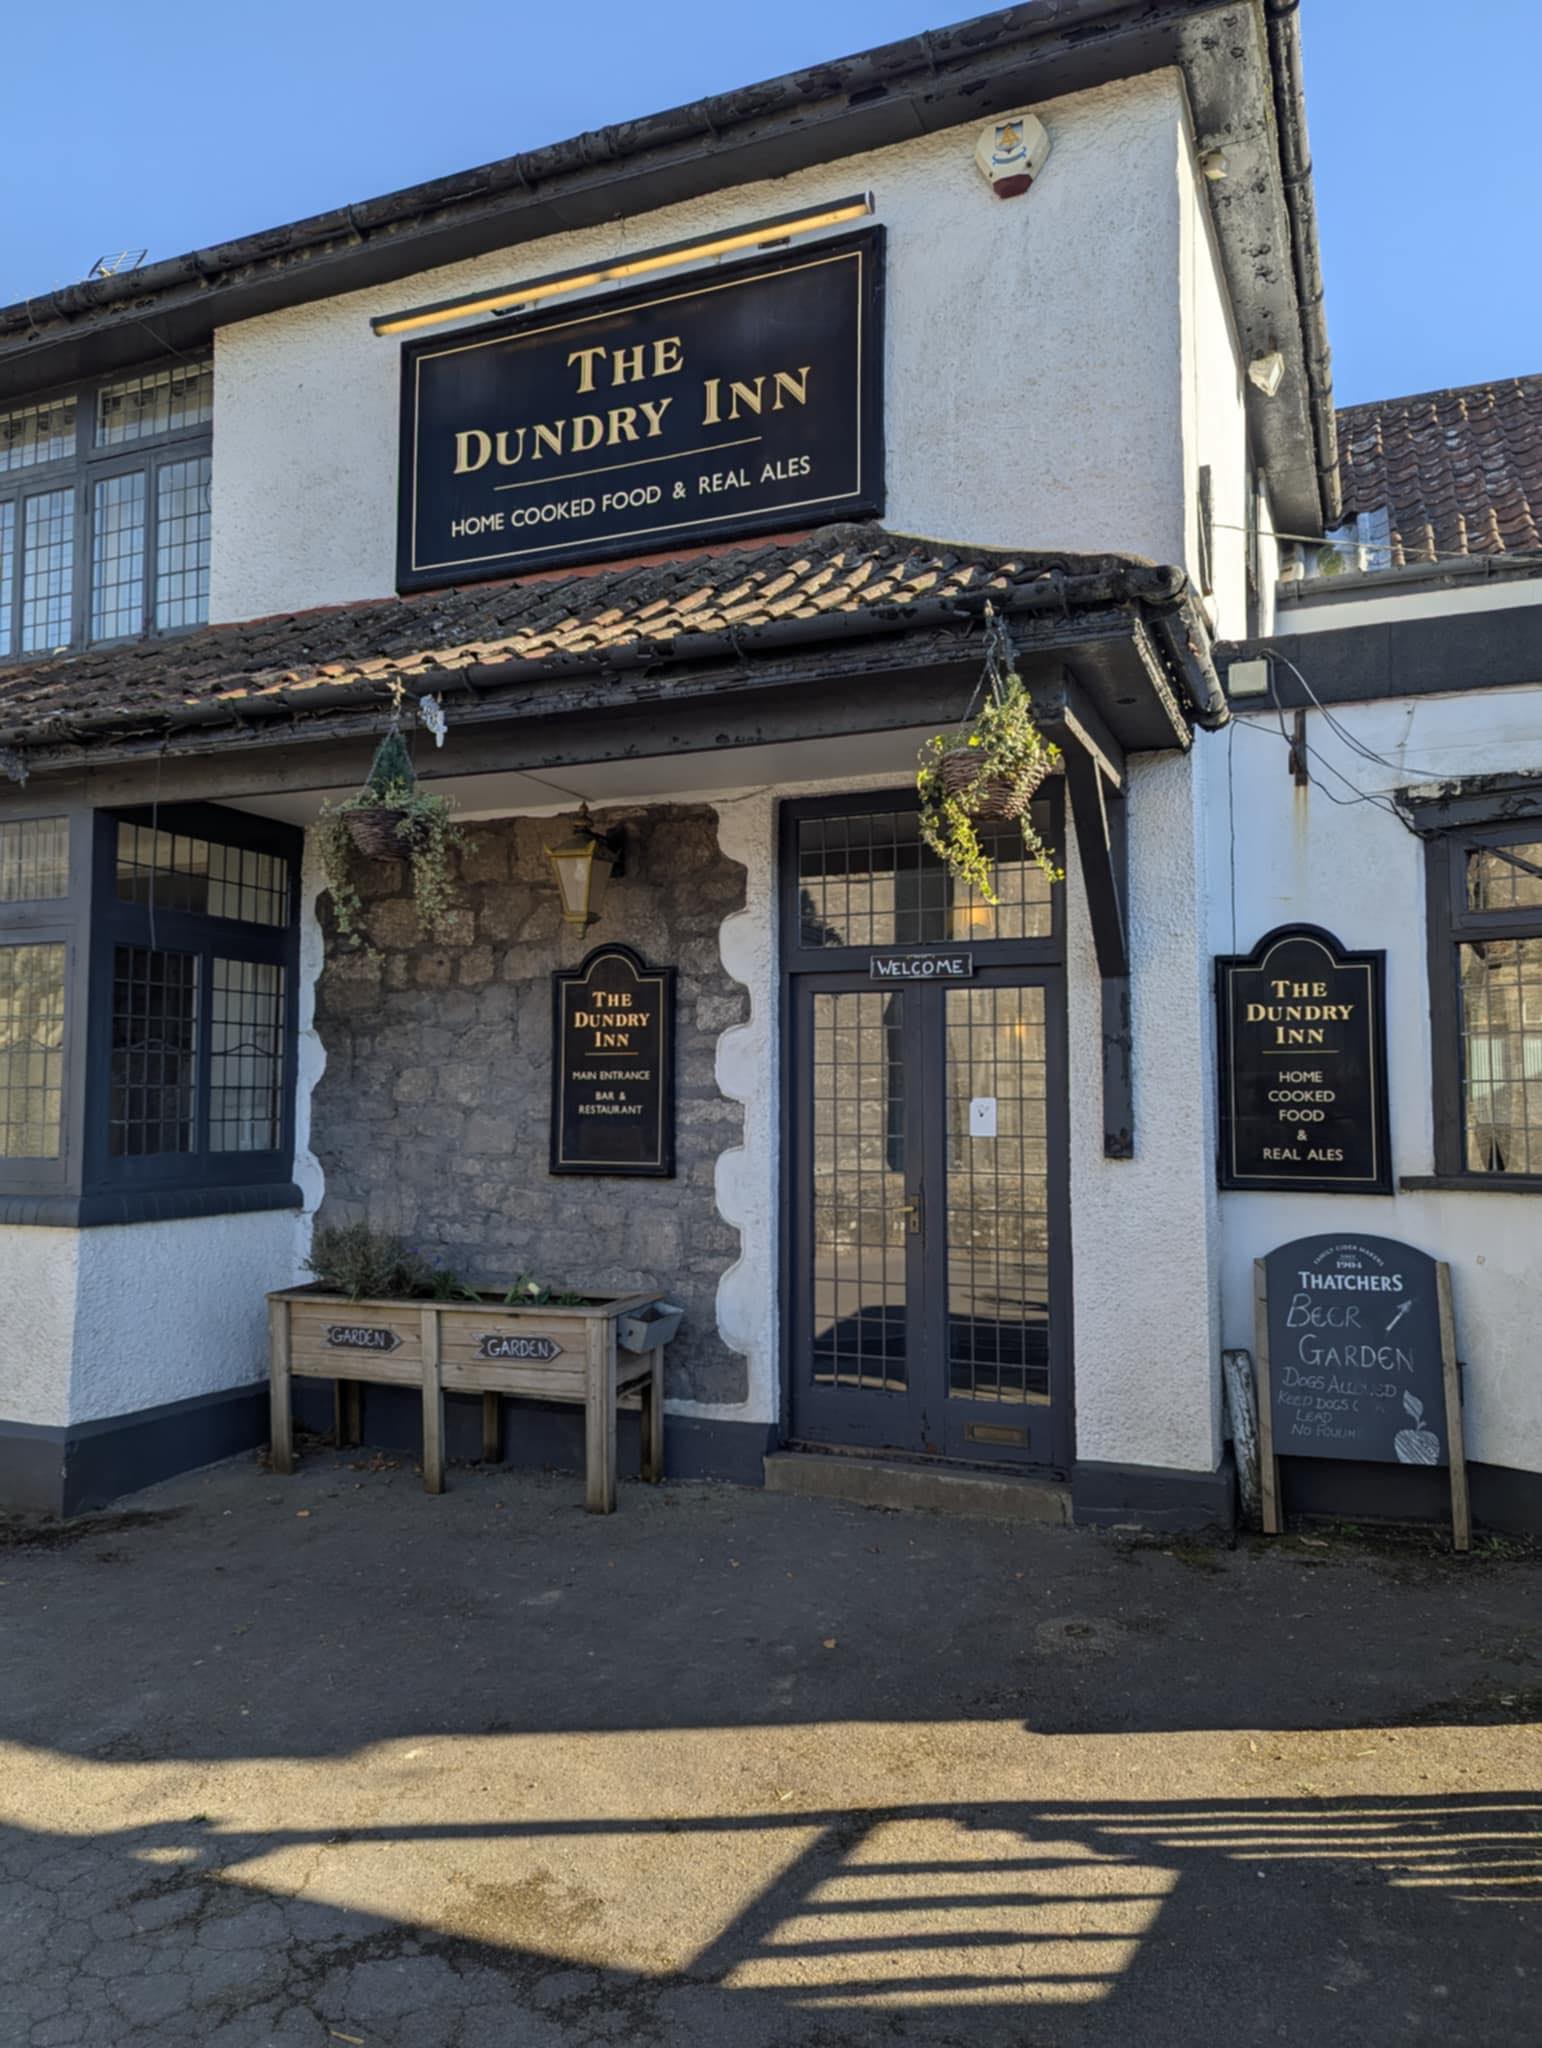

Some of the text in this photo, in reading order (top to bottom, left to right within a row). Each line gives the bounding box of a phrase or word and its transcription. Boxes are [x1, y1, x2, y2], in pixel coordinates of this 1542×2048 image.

[567, 336, 684, 394] THE
[453, 366, 811, 474] DUNDRY INN
[451, 456, 811, 537] HOME COOKED FOOD & REAL ALES
[877, 959, 964, 976] WELCOME
[1271, 980, 1328, 998] THE
[592, 991, 632, 1007] THE
[574, 1011, 650, 1028] DUNDRY
[1247, 1004, 1354, 1022] DUNDRY
[594, 1032, 629, 1047] INN
[1275, 1027, 1324, 1044] INN
[572, 1070, 650, 1080] MAIN ENTRANCE
[1279, 1071, 1323, 1083] HOME
[595, 1091, 626, 1100] BAR &
[1268, 1090, 1335, 1102] COOKED
[578, 1104, 642, 1114] RESTAURANT
[1279, 1110, 1325, 1122] FOOD
[1297, 1130, 1307, 1141] &
[1263, 1148, 1343, 1161] REAL ALES
[1298, 1271, 1403, 1292] THATCHERS
[330, 1327, 385, 1347] GARDEN
[487, 1337, 549, 1358] GARDEN
[1299, 1334, 1414, 1373] GARDEN
[1291, 1424, 1312, 1436] NO
